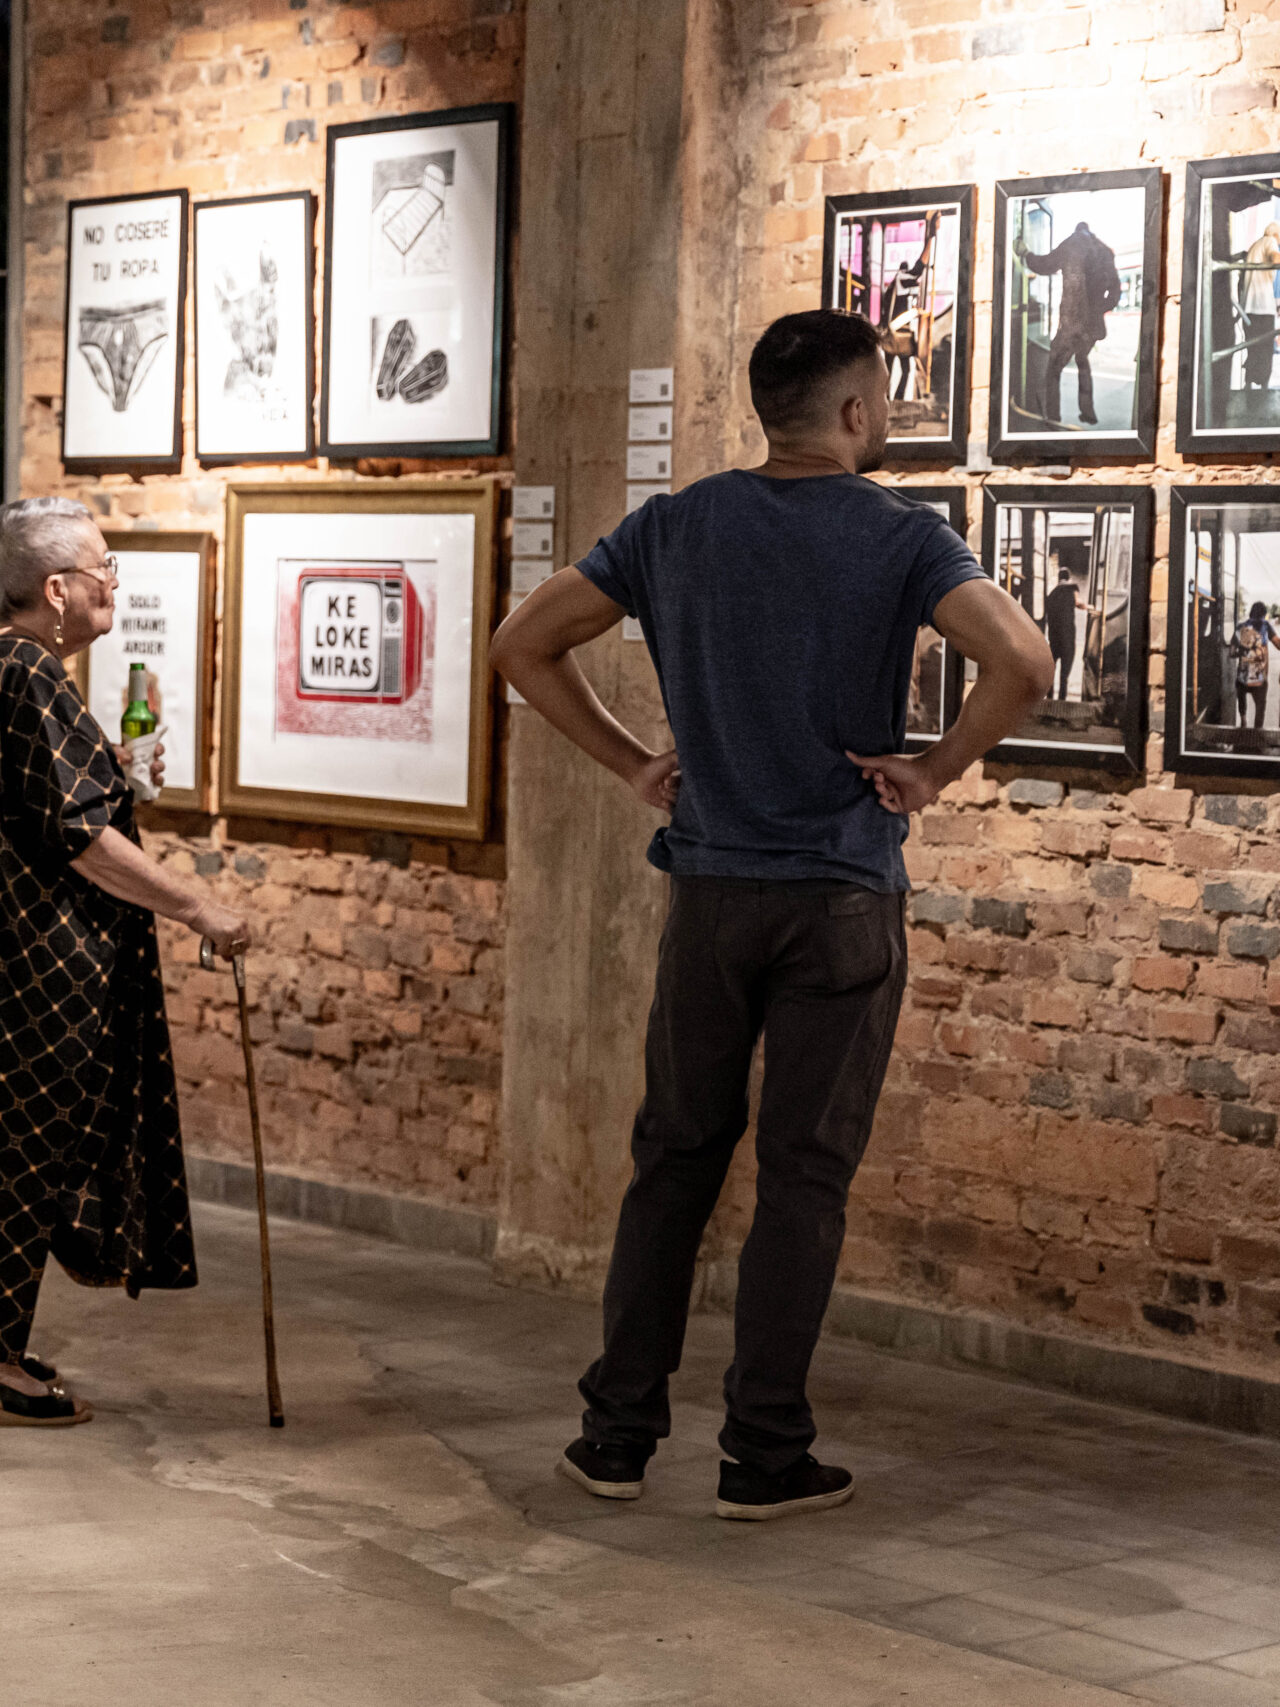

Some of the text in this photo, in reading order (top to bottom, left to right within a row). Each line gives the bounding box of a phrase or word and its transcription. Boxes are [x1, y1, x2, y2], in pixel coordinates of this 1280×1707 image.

[83, 225, 104, 245] NO
[93, 258, 160, 281] TU ROPA
[128, 594, 161, 609] SOLO
[328, 596, 356, 618] KE
[316, 626, 370, 649] LOKE
[311, 656, 372, 677] MIRAS
